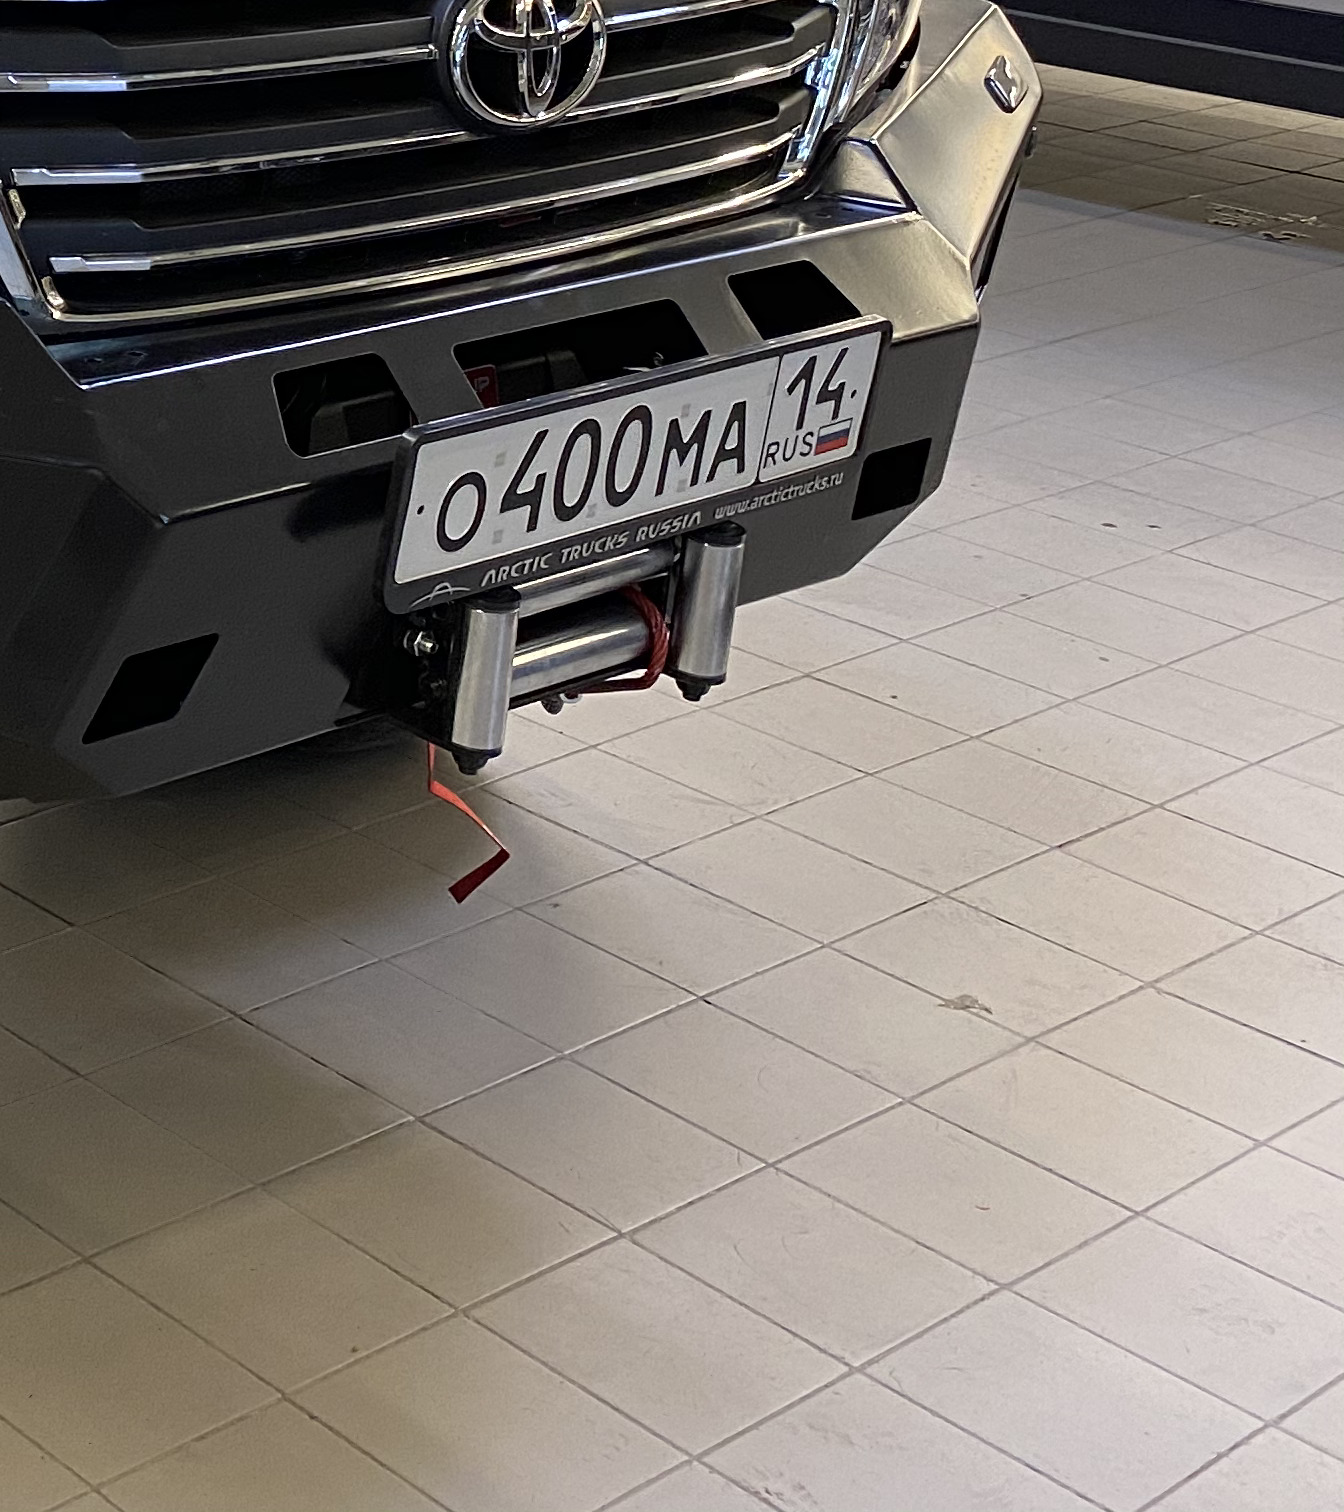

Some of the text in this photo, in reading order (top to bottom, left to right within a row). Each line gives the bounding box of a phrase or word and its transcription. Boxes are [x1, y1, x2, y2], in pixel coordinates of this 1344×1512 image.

[786, 346, 850, 431] 14
[762, 431, 815, 469] RUS
[713, 471, 845, 520] www.arctictrucks.ru
[480, 510, 703, 588] ARCTIC TRUCKS RUSSIA
